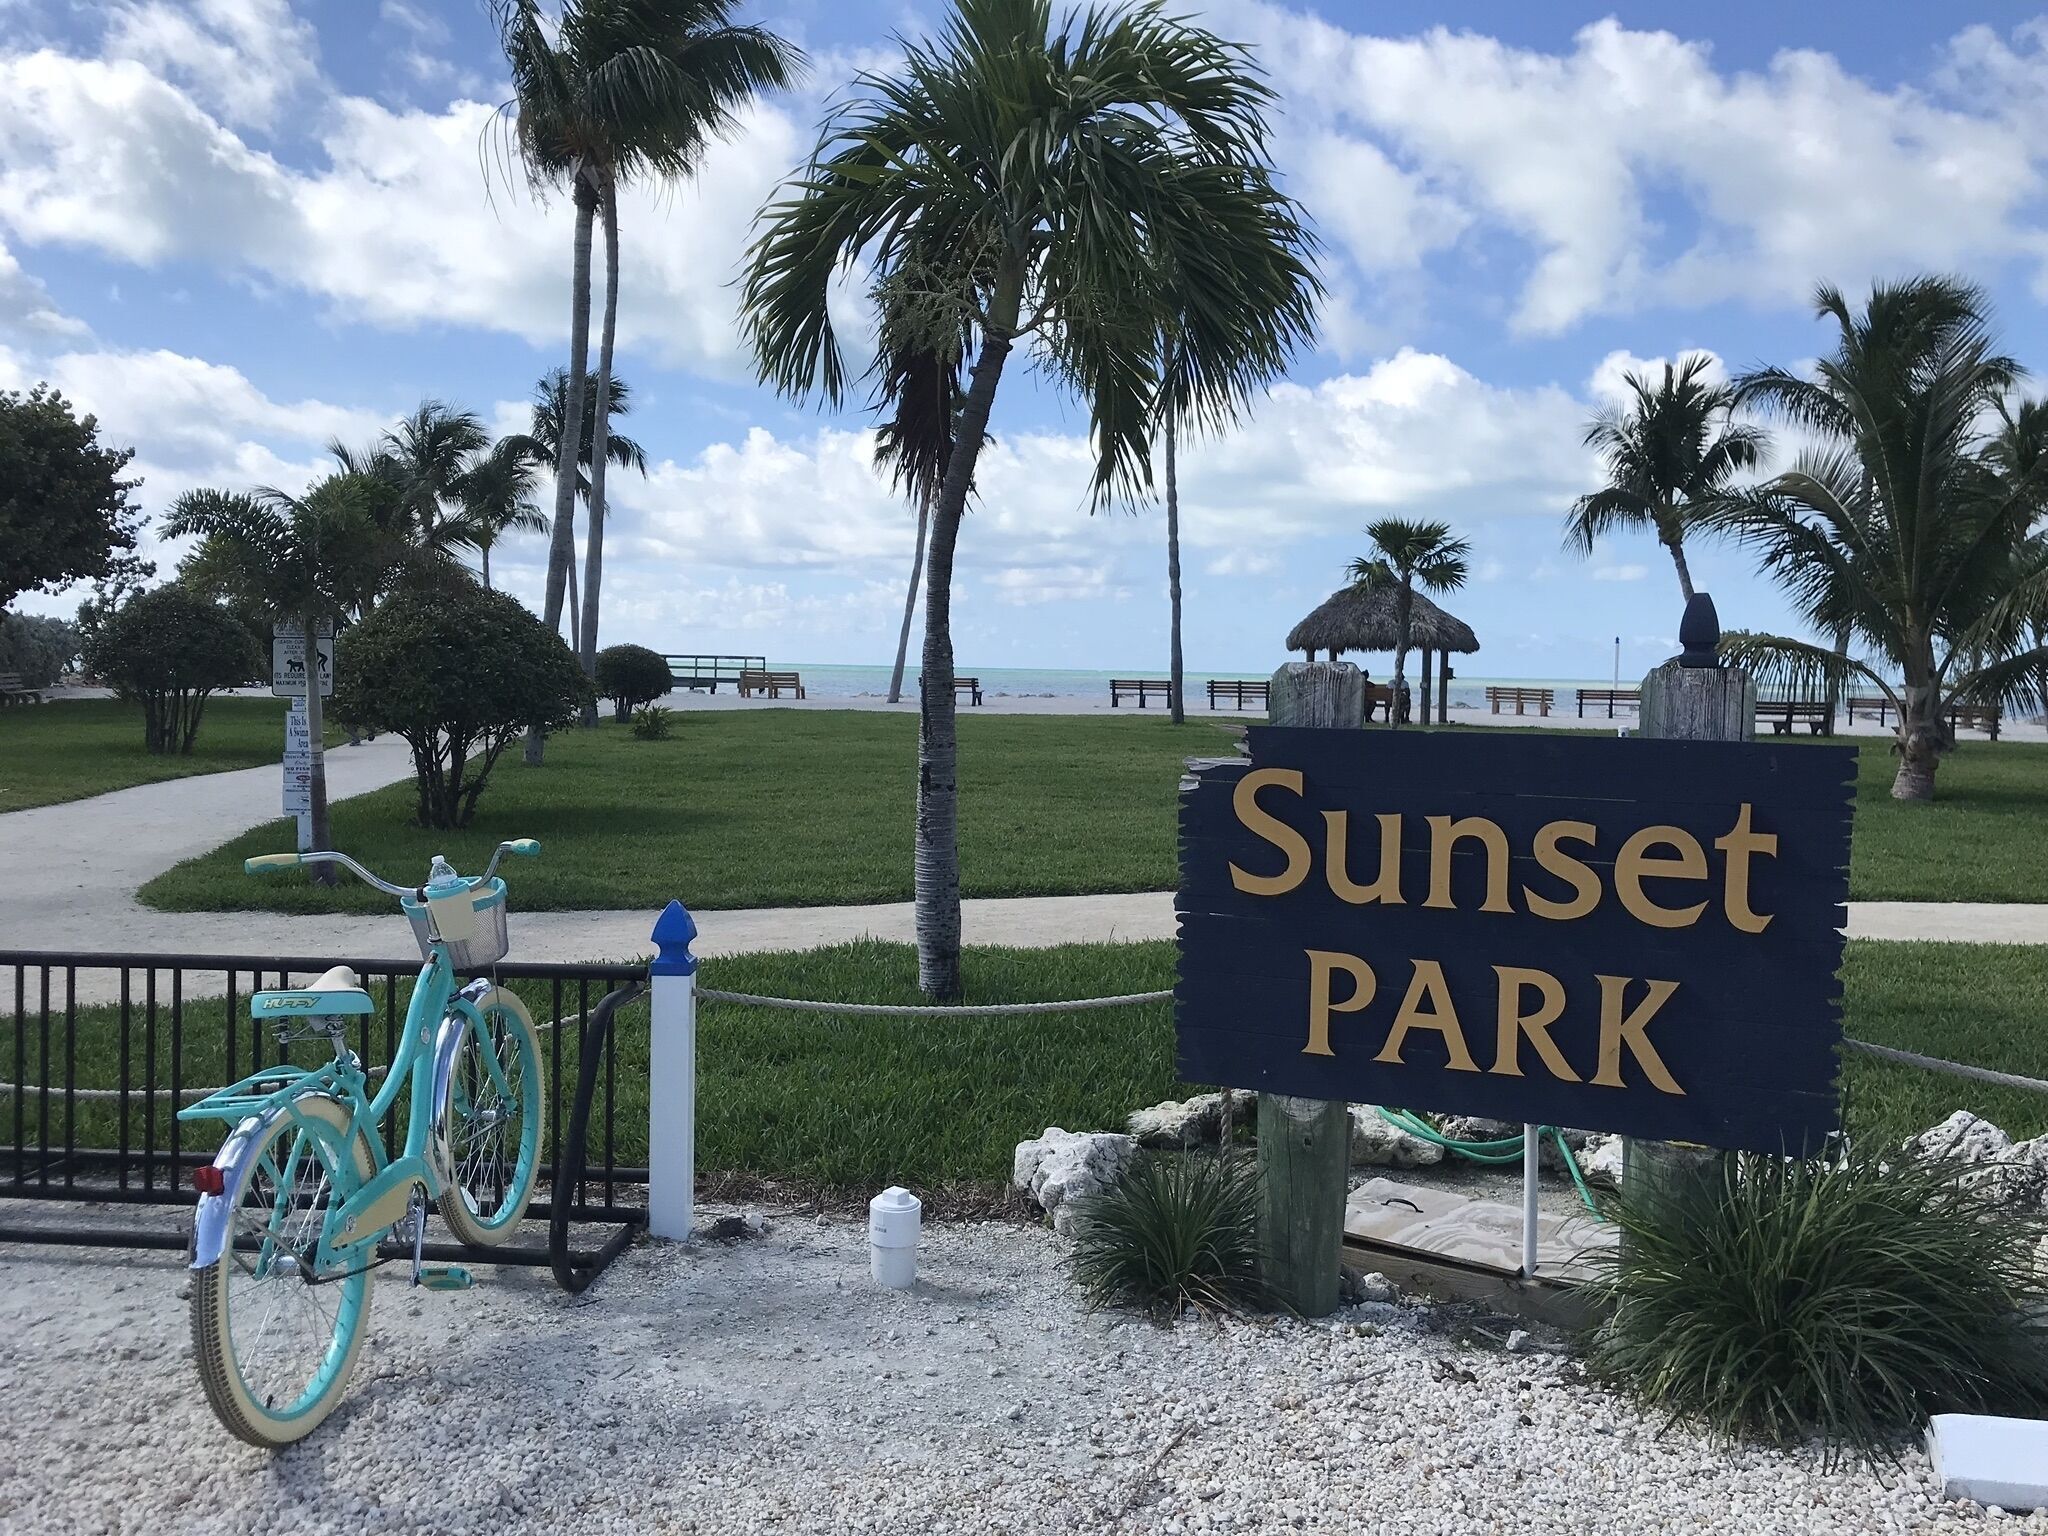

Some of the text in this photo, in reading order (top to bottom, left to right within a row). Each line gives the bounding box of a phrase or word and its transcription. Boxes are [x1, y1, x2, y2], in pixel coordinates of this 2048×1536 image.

[290, 715, 307, 726] This Is
[289, 728, 293, 737] A
[1229, 768, 1778, 934] Sunset
[262, 996, 322, 1010] HUFFY
[1301, 949, 1687, 1095] PARK
